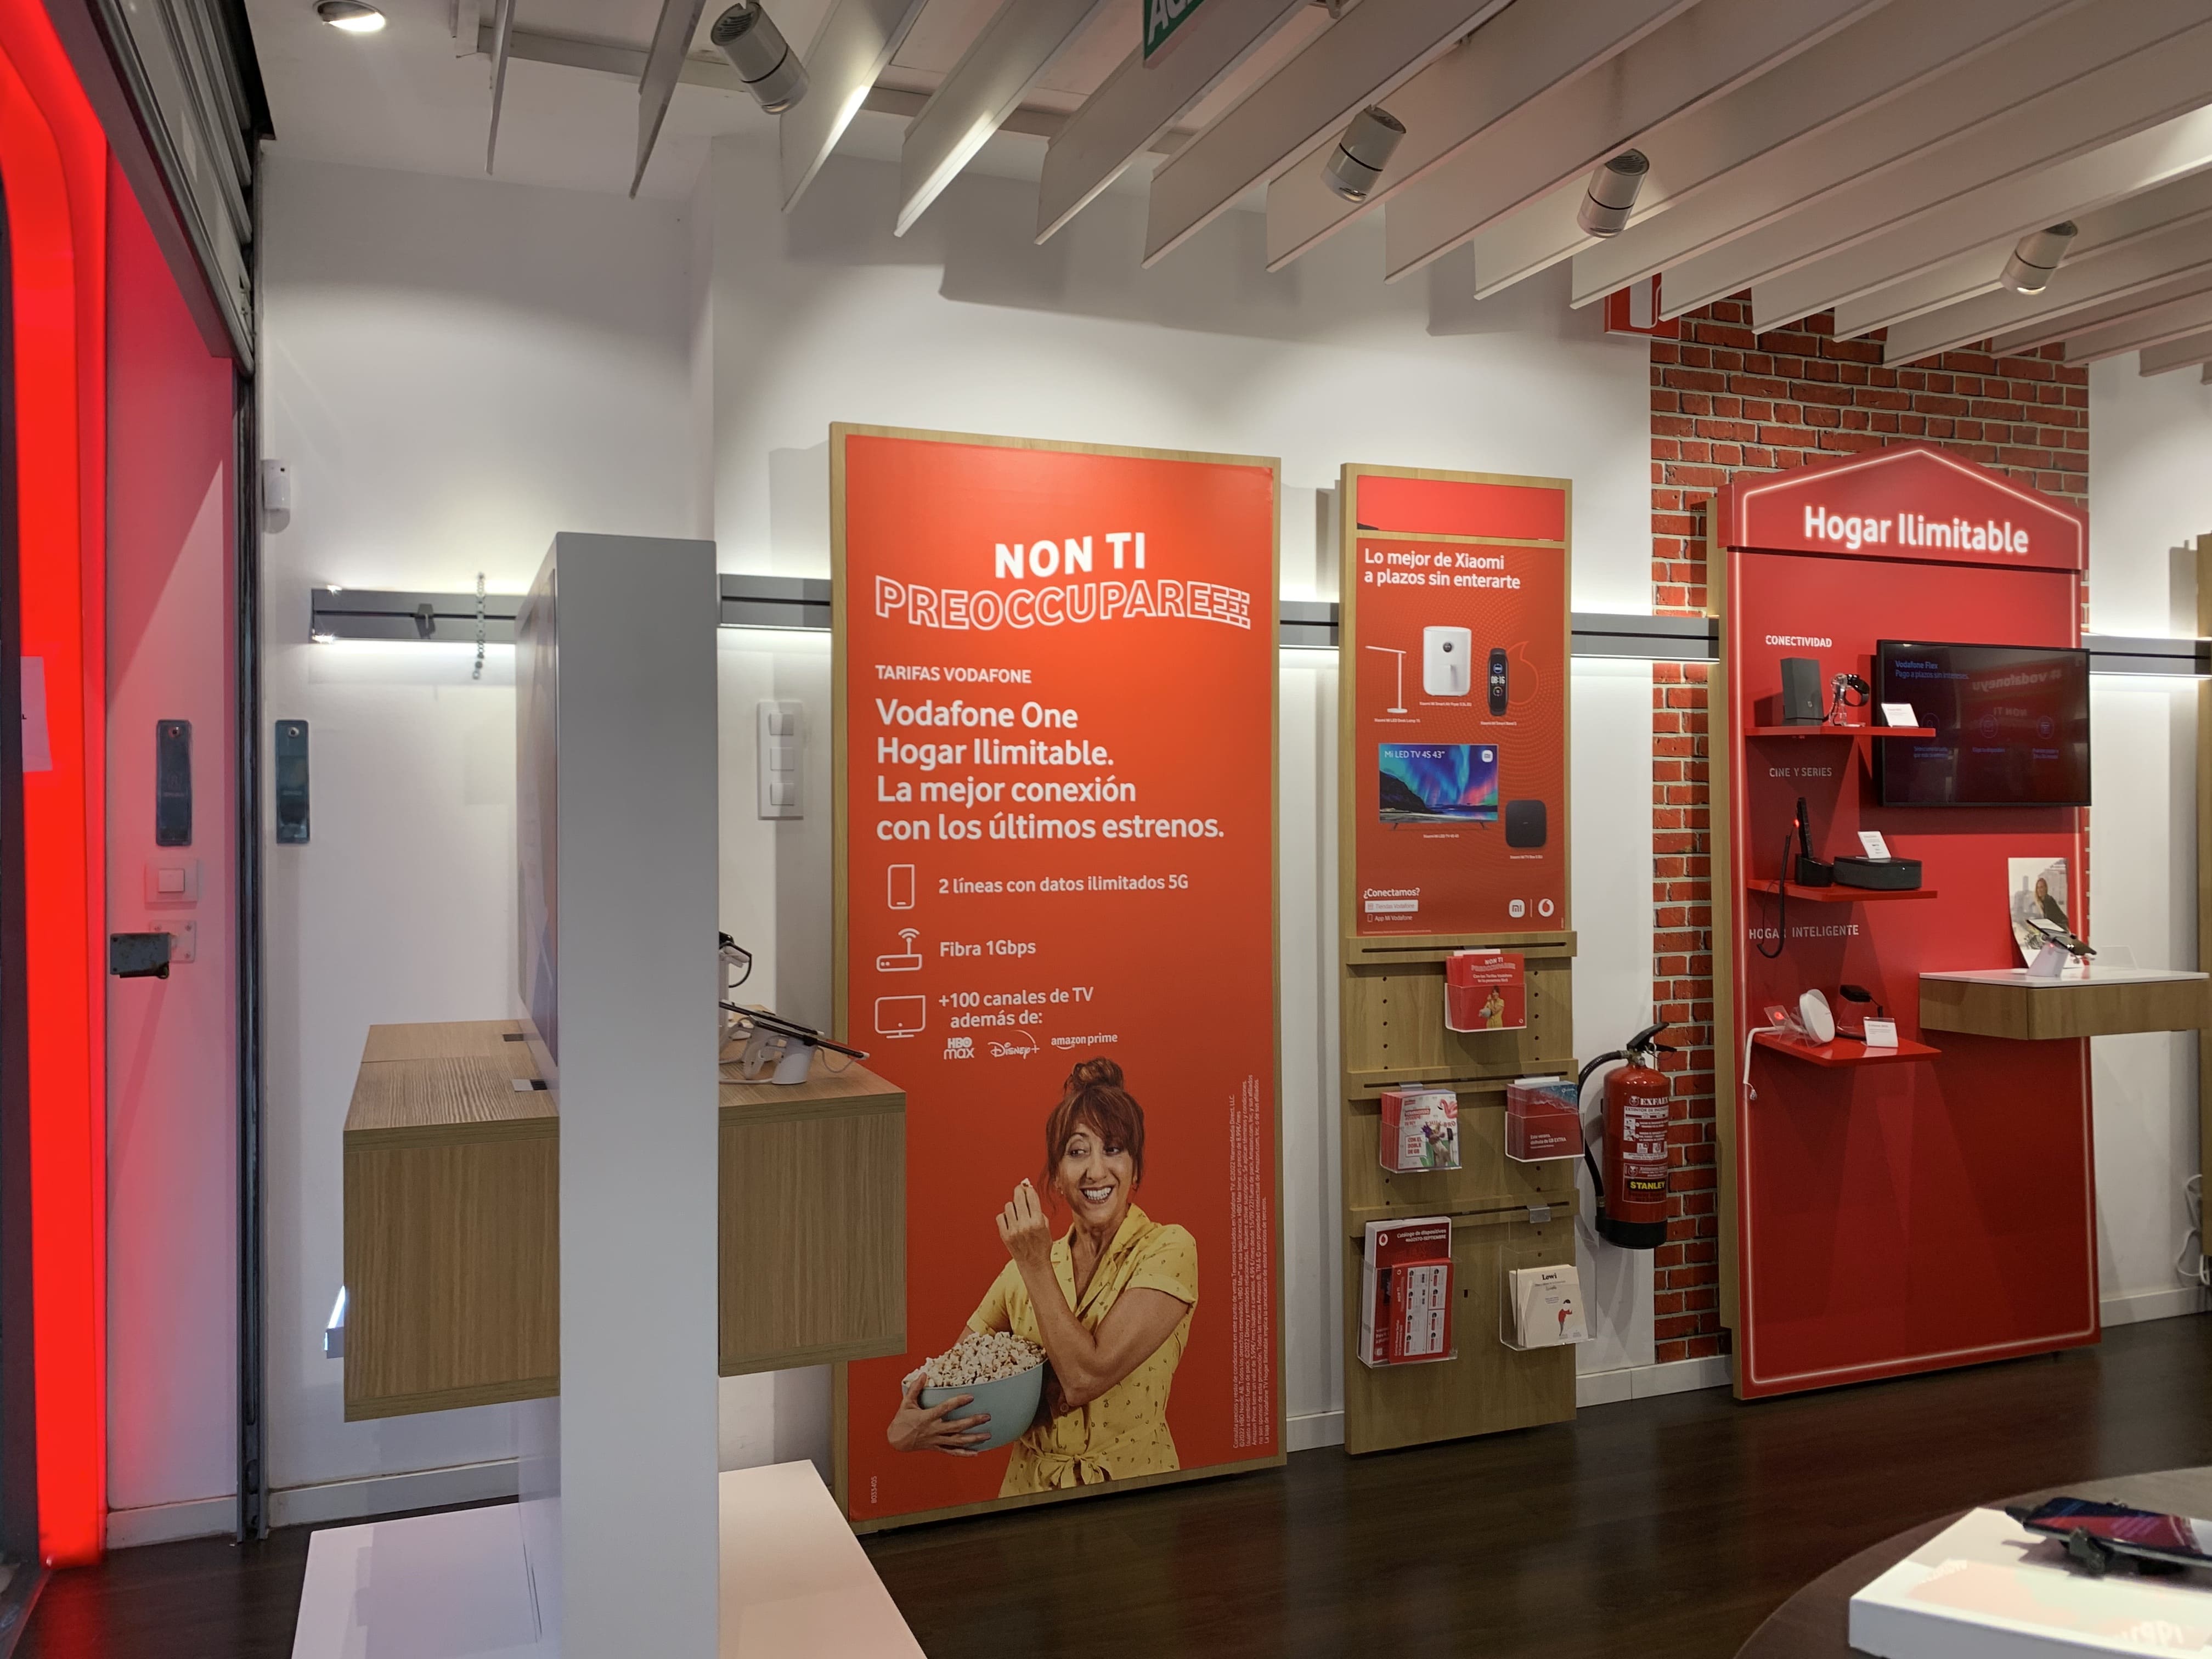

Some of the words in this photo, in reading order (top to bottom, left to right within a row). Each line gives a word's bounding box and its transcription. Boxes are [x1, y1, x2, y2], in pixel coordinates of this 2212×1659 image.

[1804, 505, 1891, 550] Hogar
[1899, 513, 2029, 553] Ilimitable
[995, 536, 1092, 579] NON
[1105, 533, 1145, 569] TI
[1364, 548, 1384, 564] Lo
[1387, 551, 1431, 569] mejor
[1434, 552, 1452, 567] de
[1455, 552, 1504, 570] Xiaomi
[1364, 572, 1373, 583] a
[1377, 569, 1425, 587] plazos
[1429, 571, 1450, 586] sin
[1453, 573, 1521, 589] enterarte
[1765, 634, 1833, 648] CONECTIVIDAD
[876, 665, 940, 681] TARIFAS
[943, 667, 1031, 684] VODAFONE
[876, 698, 1014, 727] Vodafone
[1022, 702, 1078, 729] One
[877, 737, 967, 771] Hogar
[974, 738, 1114, 766] Ilimitable.
[1769, 768, 1791, 777] CINE
[1794, 768, 1800, 777] Y
[1801, 766, 1832, 777] SERIES
[878, 775, 912, 802] La
[920, 776, 1005, 809] mejor
[1011, 775, 1136, 803] conexión
[877, 819, 930, 840] con
[938, 814, 981, 839] los
[989, 811, 1096, 839] últimos
[1102, 815, 1224, 838] estrenos.
[938, 879, 949, 894] 2
[953, 877, 1003, 894] líneas
[1006, 879, 1036, 893] con
[1040, 876, 1084, 891] datos
[1087, 875, 1165, 891] ilimitados
[1169, 874, 1188, 889] 5G
[1363, 887, 1420, 899] ¿Conectamos?
[1748, 928, 1785, 940] HOGA
[1792, 924, 1859, 938] INTELIGENTE
[939, 941, 981, 956] Fibra
[986, 939, 1036, 958] 1Gbps
[939, 992, 980, 1008] +100
[983, 990, 1046, 1007] canales
[1049, 989, 1069, 1003] de
[1072, 986, 1093, 1001] TV
[950, 1010, 1014, 1029] además
[1019, 1010, 1043, 1025] de:
[947, 1037, 972, 1049] HBO
[1051, 1035, 1086, 1047] amazon
[1087, 1032, 1118, 1046] prime
[944, 1047, 974, 1059] max
[1630, 1181, 1665, 1189] STANLEY
